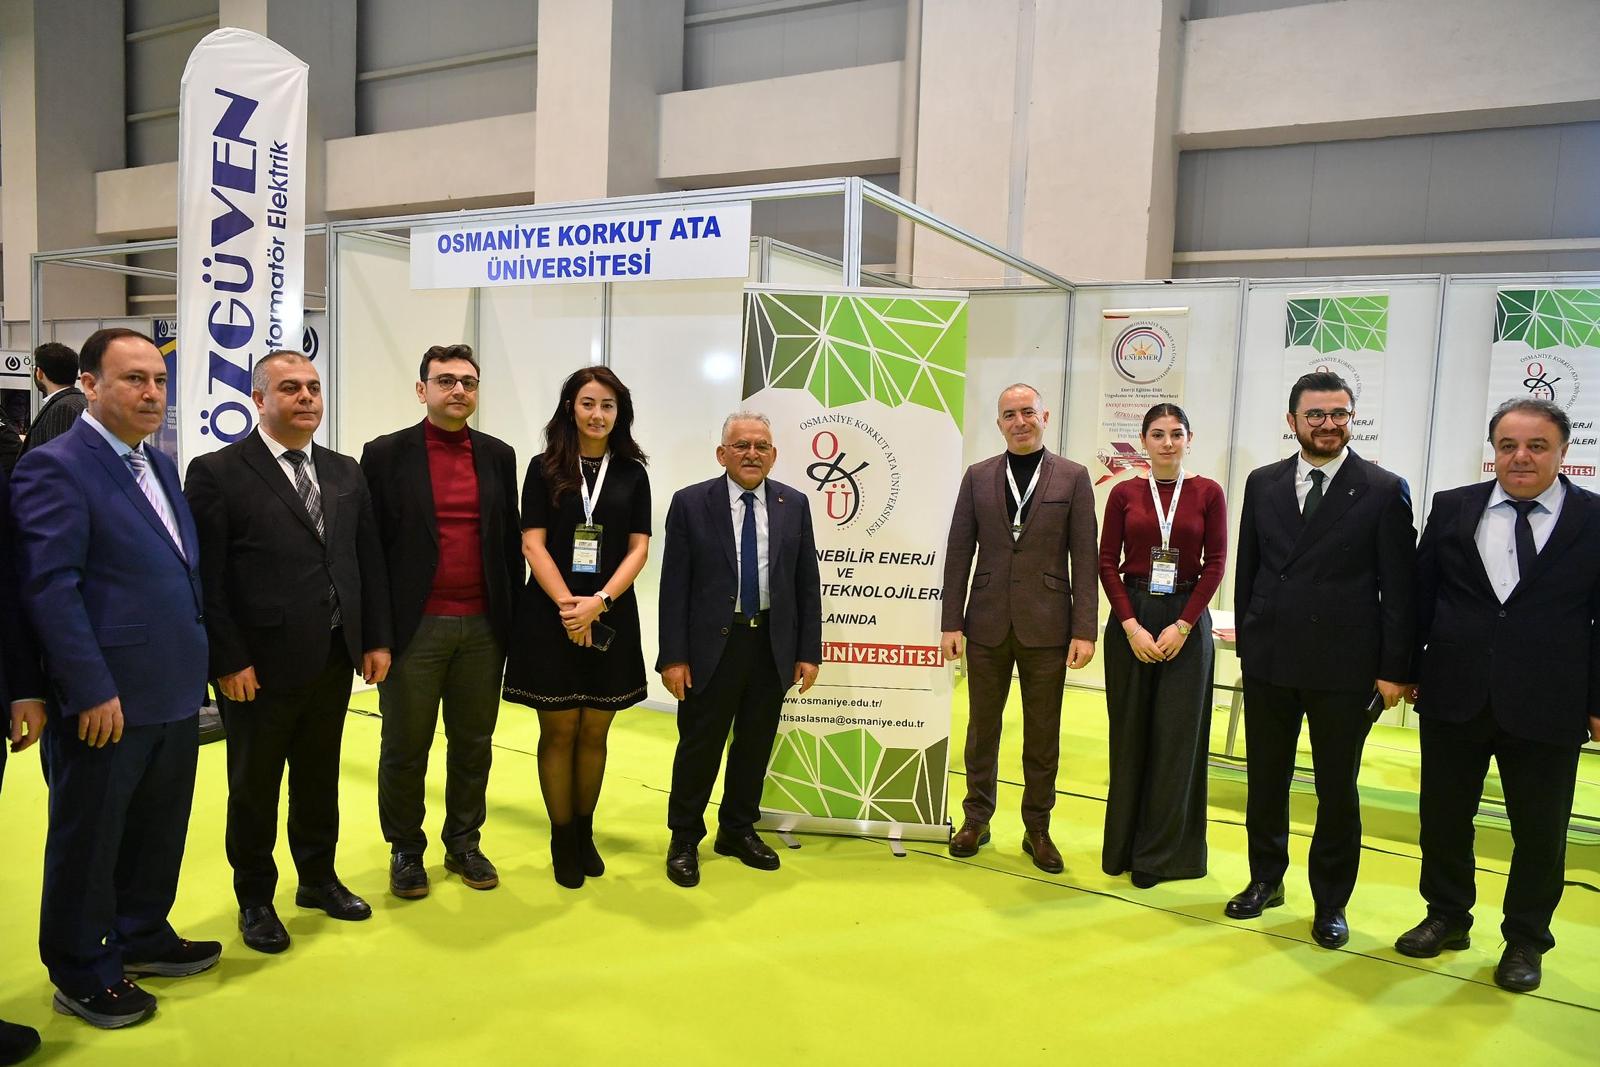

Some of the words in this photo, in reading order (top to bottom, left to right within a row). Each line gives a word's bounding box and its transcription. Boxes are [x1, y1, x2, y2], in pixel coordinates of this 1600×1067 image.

[267, 139, 289, 229] Elektrik
[437, 224, 550, 254] OSMANİYE
[558, 219, 662, 247] KORKUT
[670, 216, 721, 240] ATA
[199, 87, 259, 443] ÖZGÜVEN
[487, 247, 651, 281] ÜNİVERSİTESİ
[799, 412, 853, 431] OSMANİYE
[1352, 418, 1374, 426] NERJİ
[854, 419, 890, 450] KORKUT
[1350, 433, 1379, 441] OJİLERİ
[884, 450, 898, 471] ATA
[1560, 465, 1595, 476] RSİTESİ
[865, 472, 902, 537] ÜNİVERSİTESİ
[816, 548, 875, 563] NEBİLİR
[879, 551, 936, 566] ENERJİ
[836, 568, 854, 579] VE
[822, 642, 944, 666] ÜNİVERSİTESİ
[783, 697, 882, 708] ww.osmaniye.edu.tr/
[780, 714, 925, 728] tisaslasma@osmaniye.edu.tr
